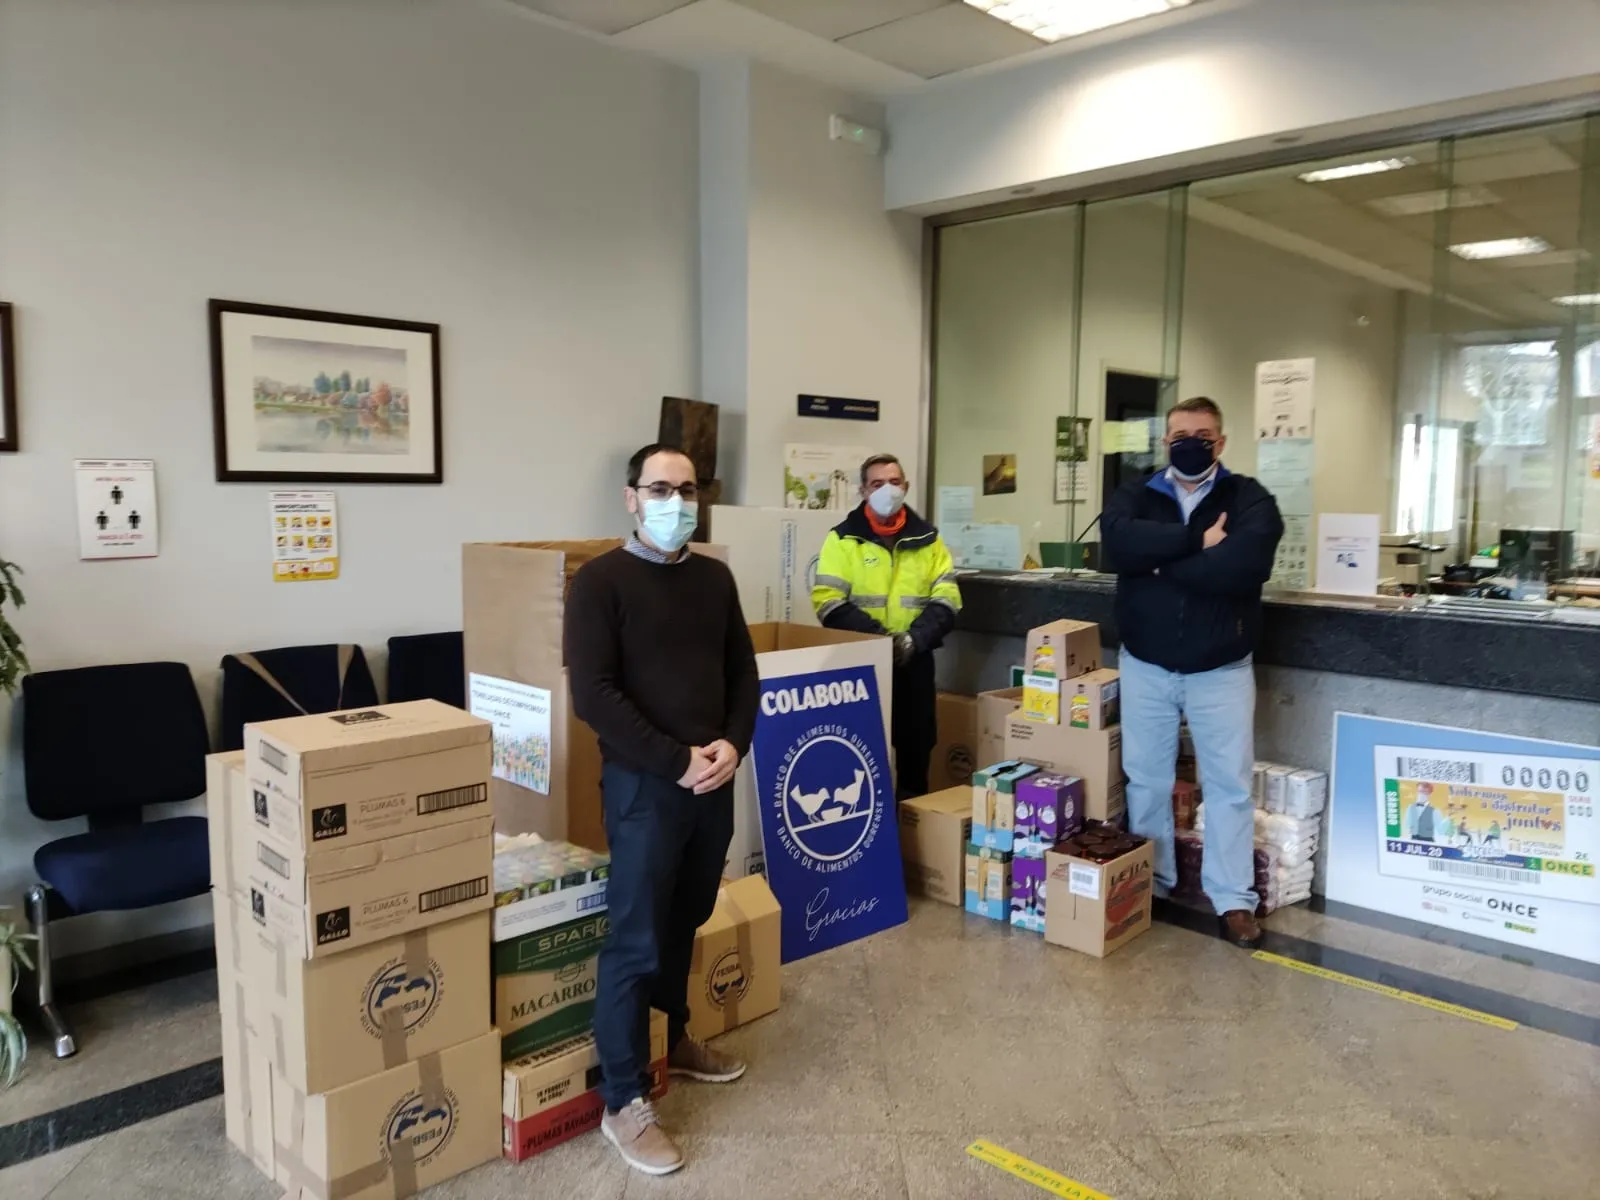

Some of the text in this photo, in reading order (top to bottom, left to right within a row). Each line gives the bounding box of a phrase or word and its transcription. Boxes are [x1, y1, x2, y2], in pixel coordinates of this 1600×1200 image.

[761, 679, 870, 717] COLABORA
[773, 724, 880, 808] BANCO DE ALIMENTOS OURENSE
[1502, 765, 1589, 793] 00000
[314, 825, 346, 840] GALLO
[776, 800, 884, 873] BANCO DE ALIMENTOS OURENSE
[1388, 842, 1402, 853] 11
[1545, 860, 1593, 876] ONCE
[805, 887, 880, 942] Gracias
[1422, 884, 1452, 898] grupo
[1454, 890, 1483, 904] social
[1487, 897, 1539, 919] ONCE
[319, 927, 349, 943] GALLO
[538, 923, 597, 954] SPAR
[510, 977, 597, 1022] MACARRO
[526, 1124, 563, 1150] PLUMAS
